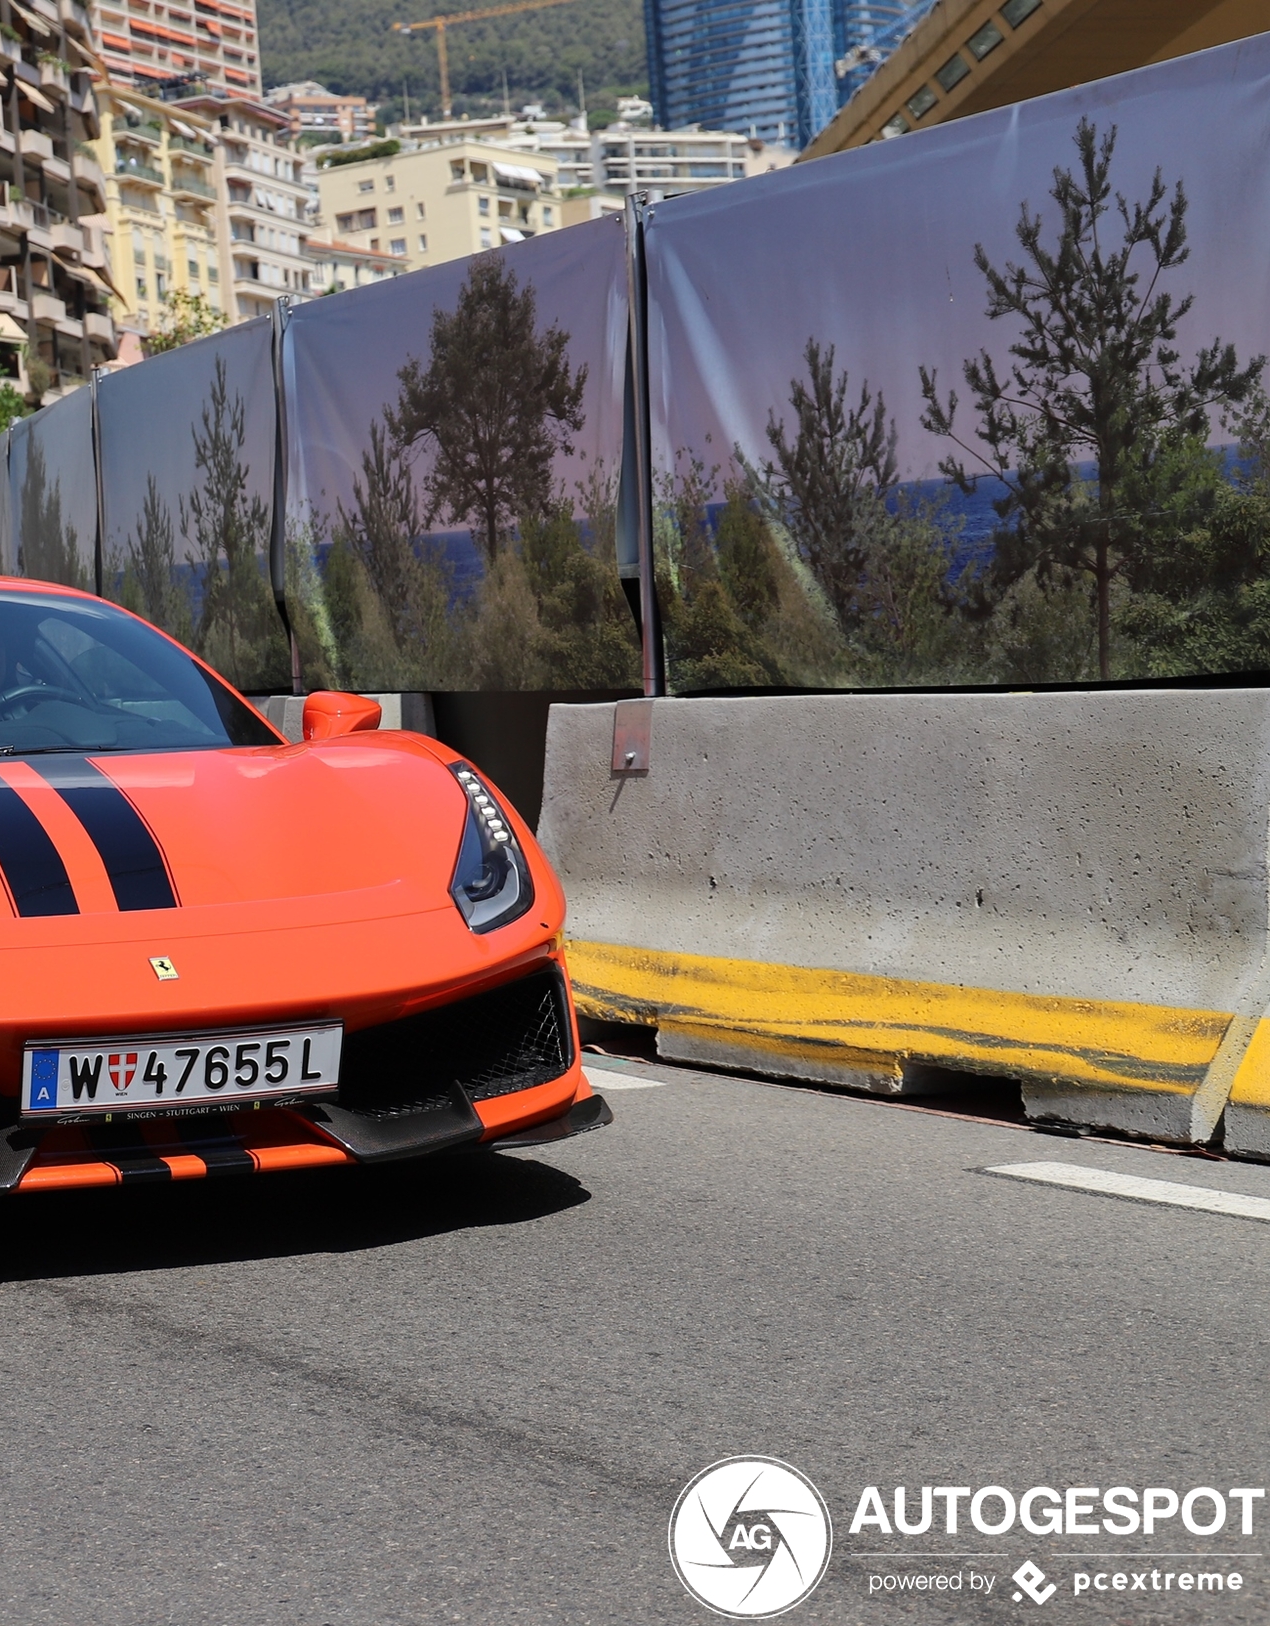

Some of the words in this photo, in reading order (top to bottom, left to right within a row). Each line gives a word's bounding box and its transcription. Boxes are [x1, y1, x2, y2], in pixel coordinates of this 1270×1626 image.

[69, 1054, 103, 1100] W
[37, 1087, 50, 1100] A
[127, 1109, 157, 1120] SINGEN
[166, 1106, 210, 1117] STUTTGART
[219, 1104, 240, 1112] WIEN
